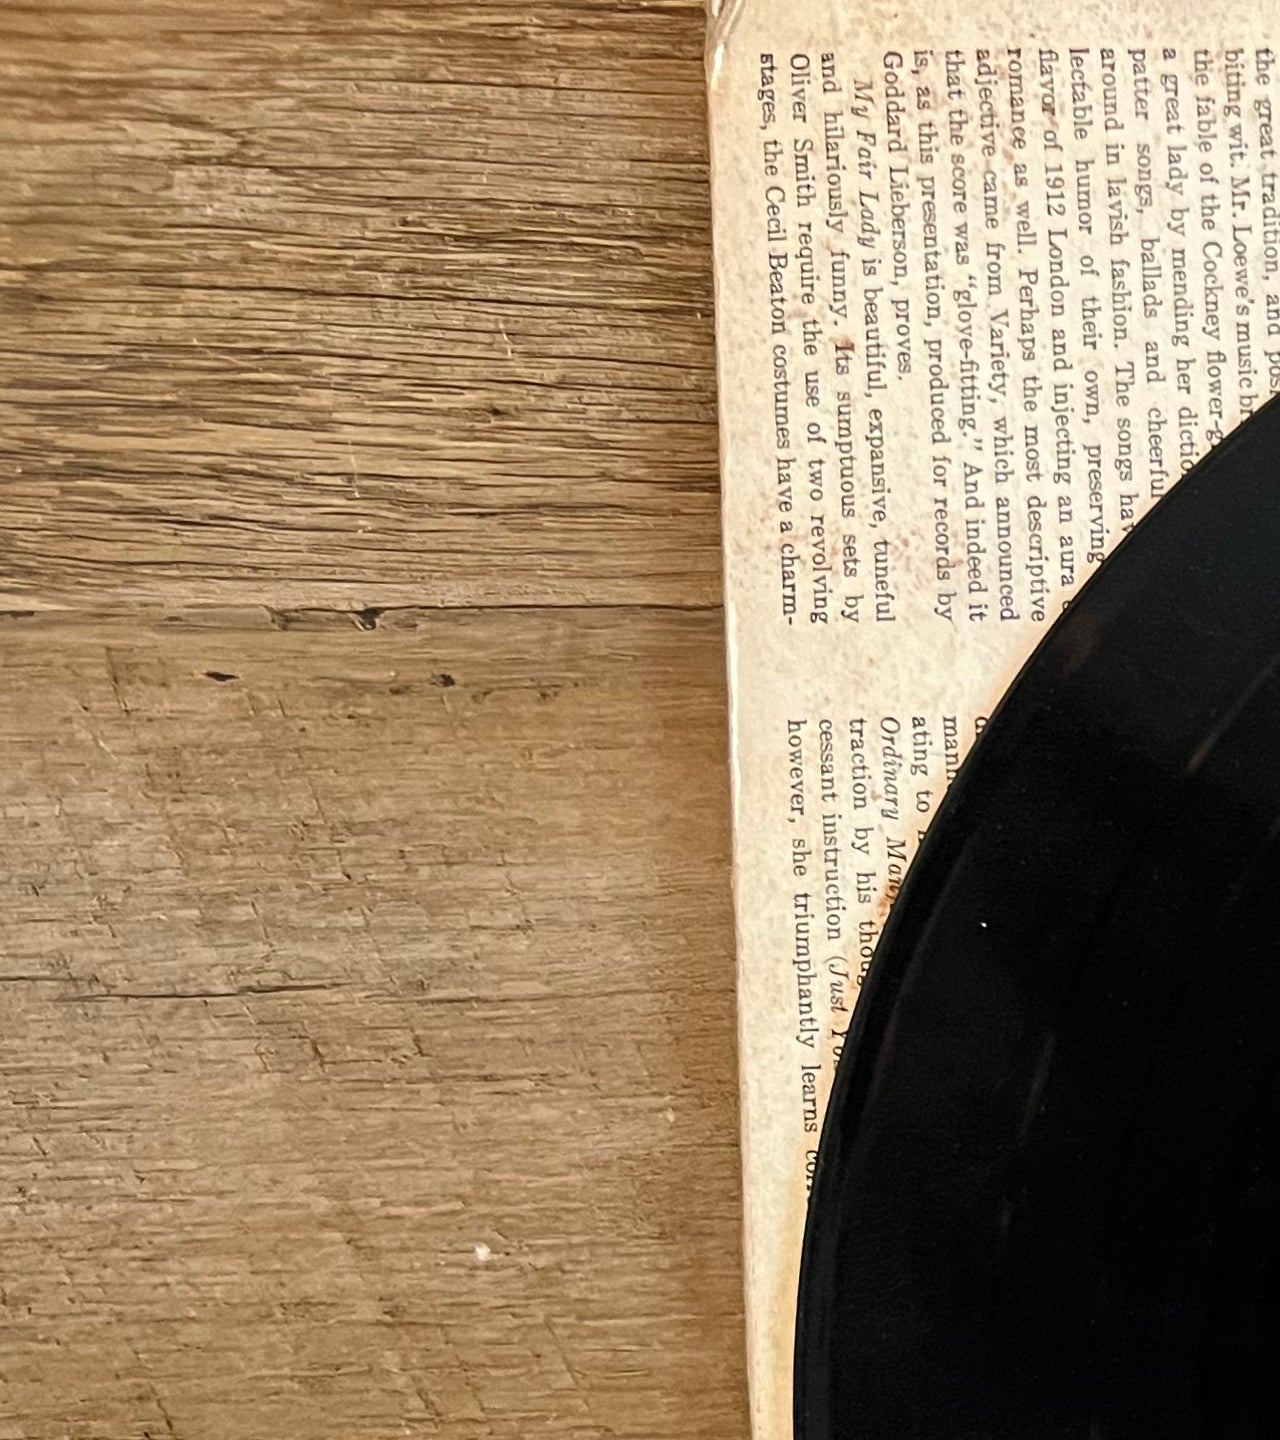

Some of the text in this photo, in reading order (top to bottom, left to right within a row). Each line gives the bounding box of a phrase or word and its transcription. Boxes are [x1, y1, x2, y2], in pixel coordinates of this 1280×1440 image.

[851, 78, 896, 622] My Fair Lady is beautiful, expansive, tuneful
[883, 51, 913, 381] Goddard Lieberson, proves.
[785, 719, 822, 1133] however, she triumphantly learns
